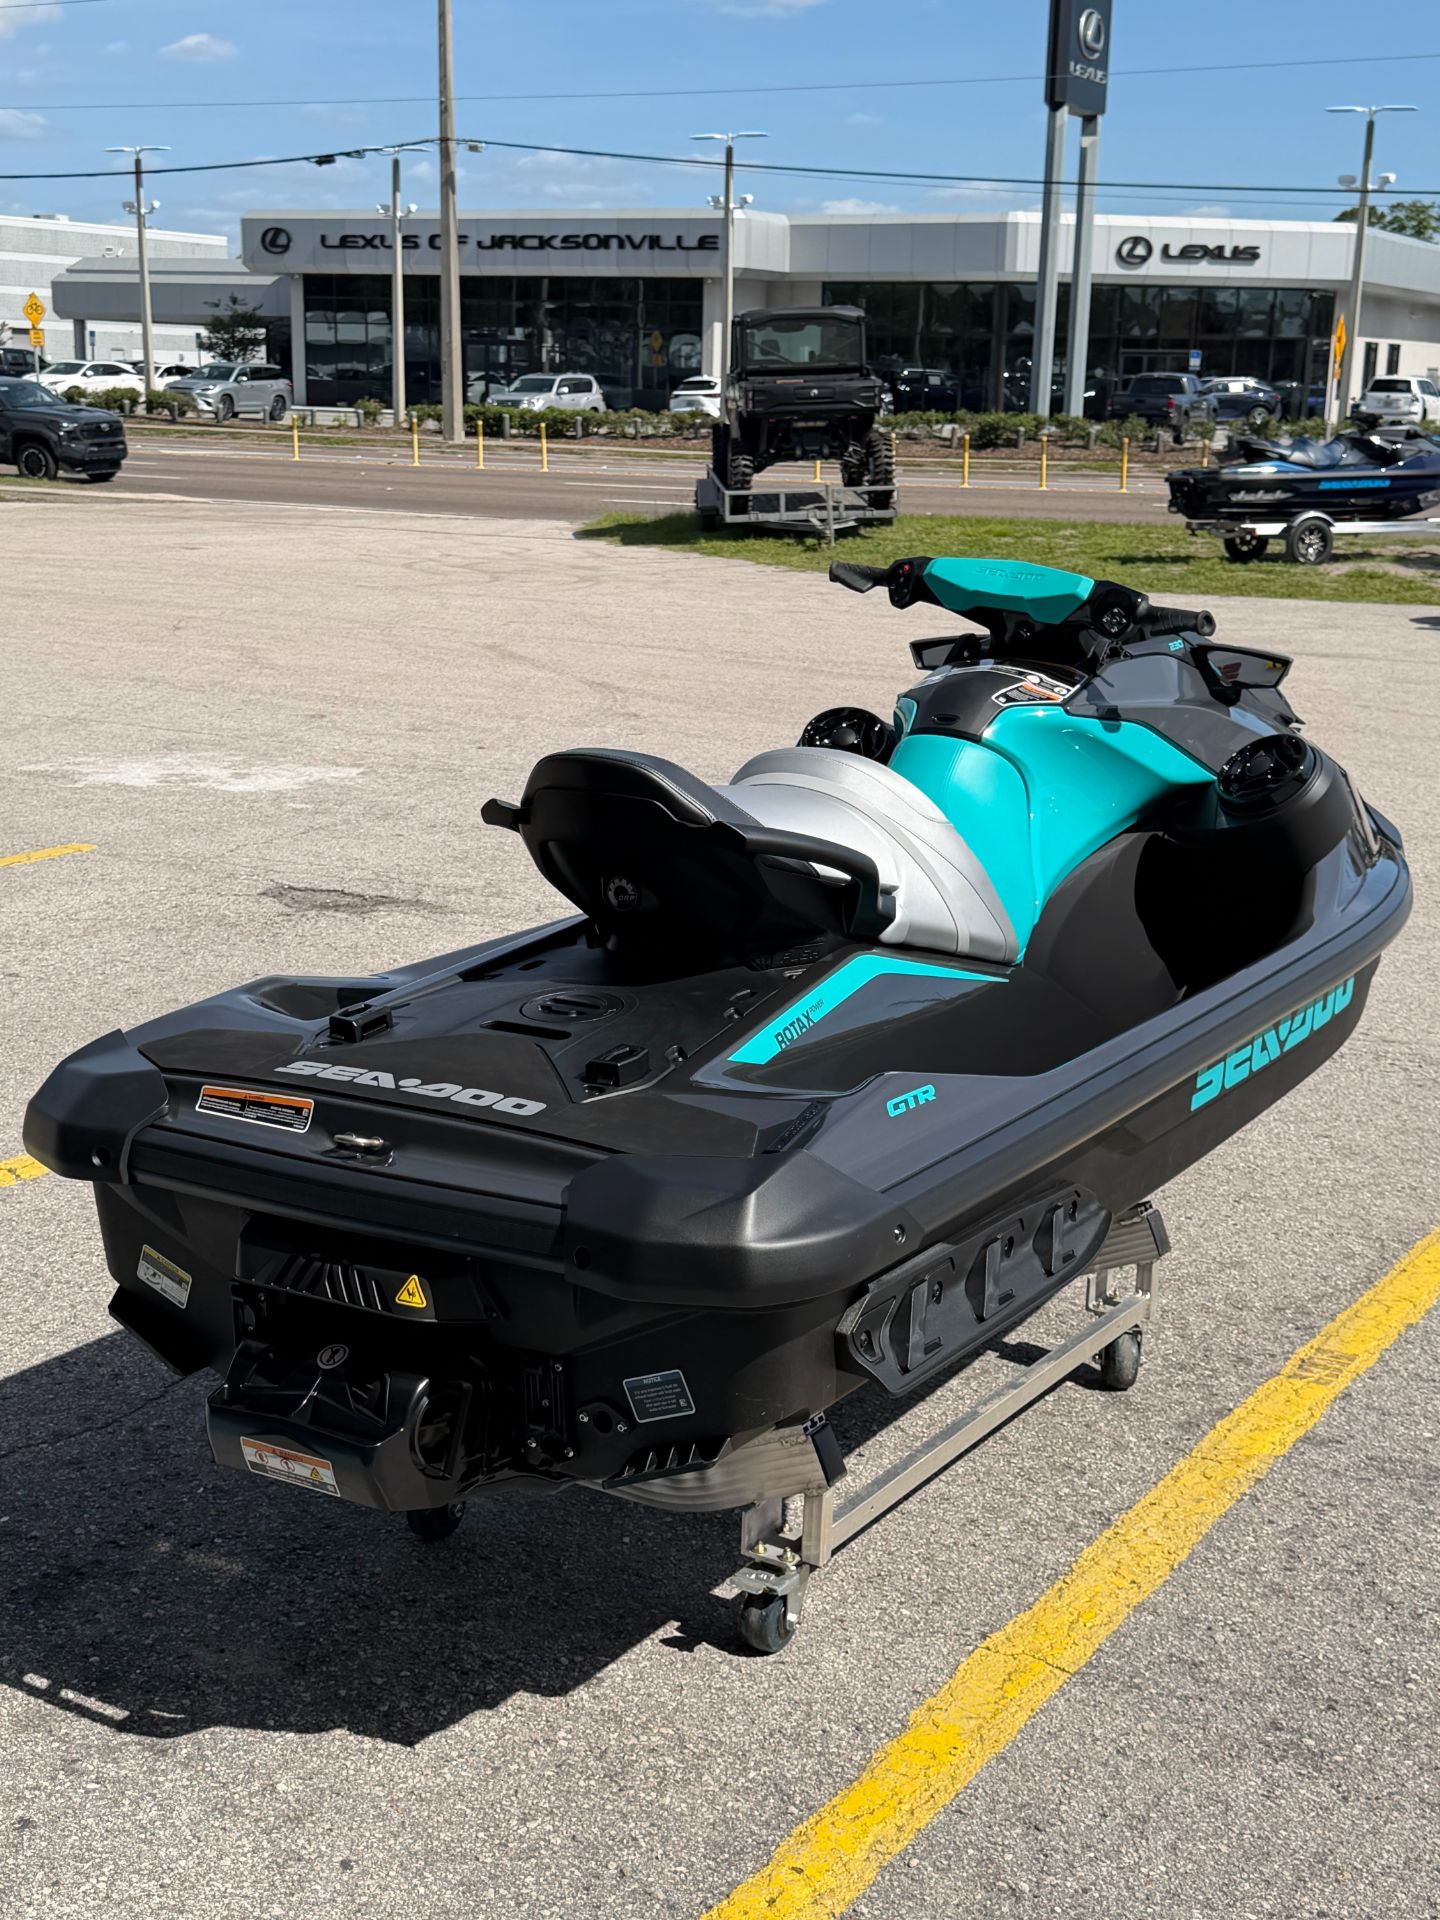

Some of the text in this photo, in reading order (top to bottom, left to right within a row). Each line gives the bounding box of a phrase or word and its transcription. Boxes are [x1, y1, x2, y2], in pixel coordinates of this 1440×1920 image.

[477, 234, 719, 251] JACKSONVILLE
[1162, 243, 1261, 262] LEXUS
[774, 1009, 816, 1050] ROTAX
[886, 1084, 937, 1118] GTR
